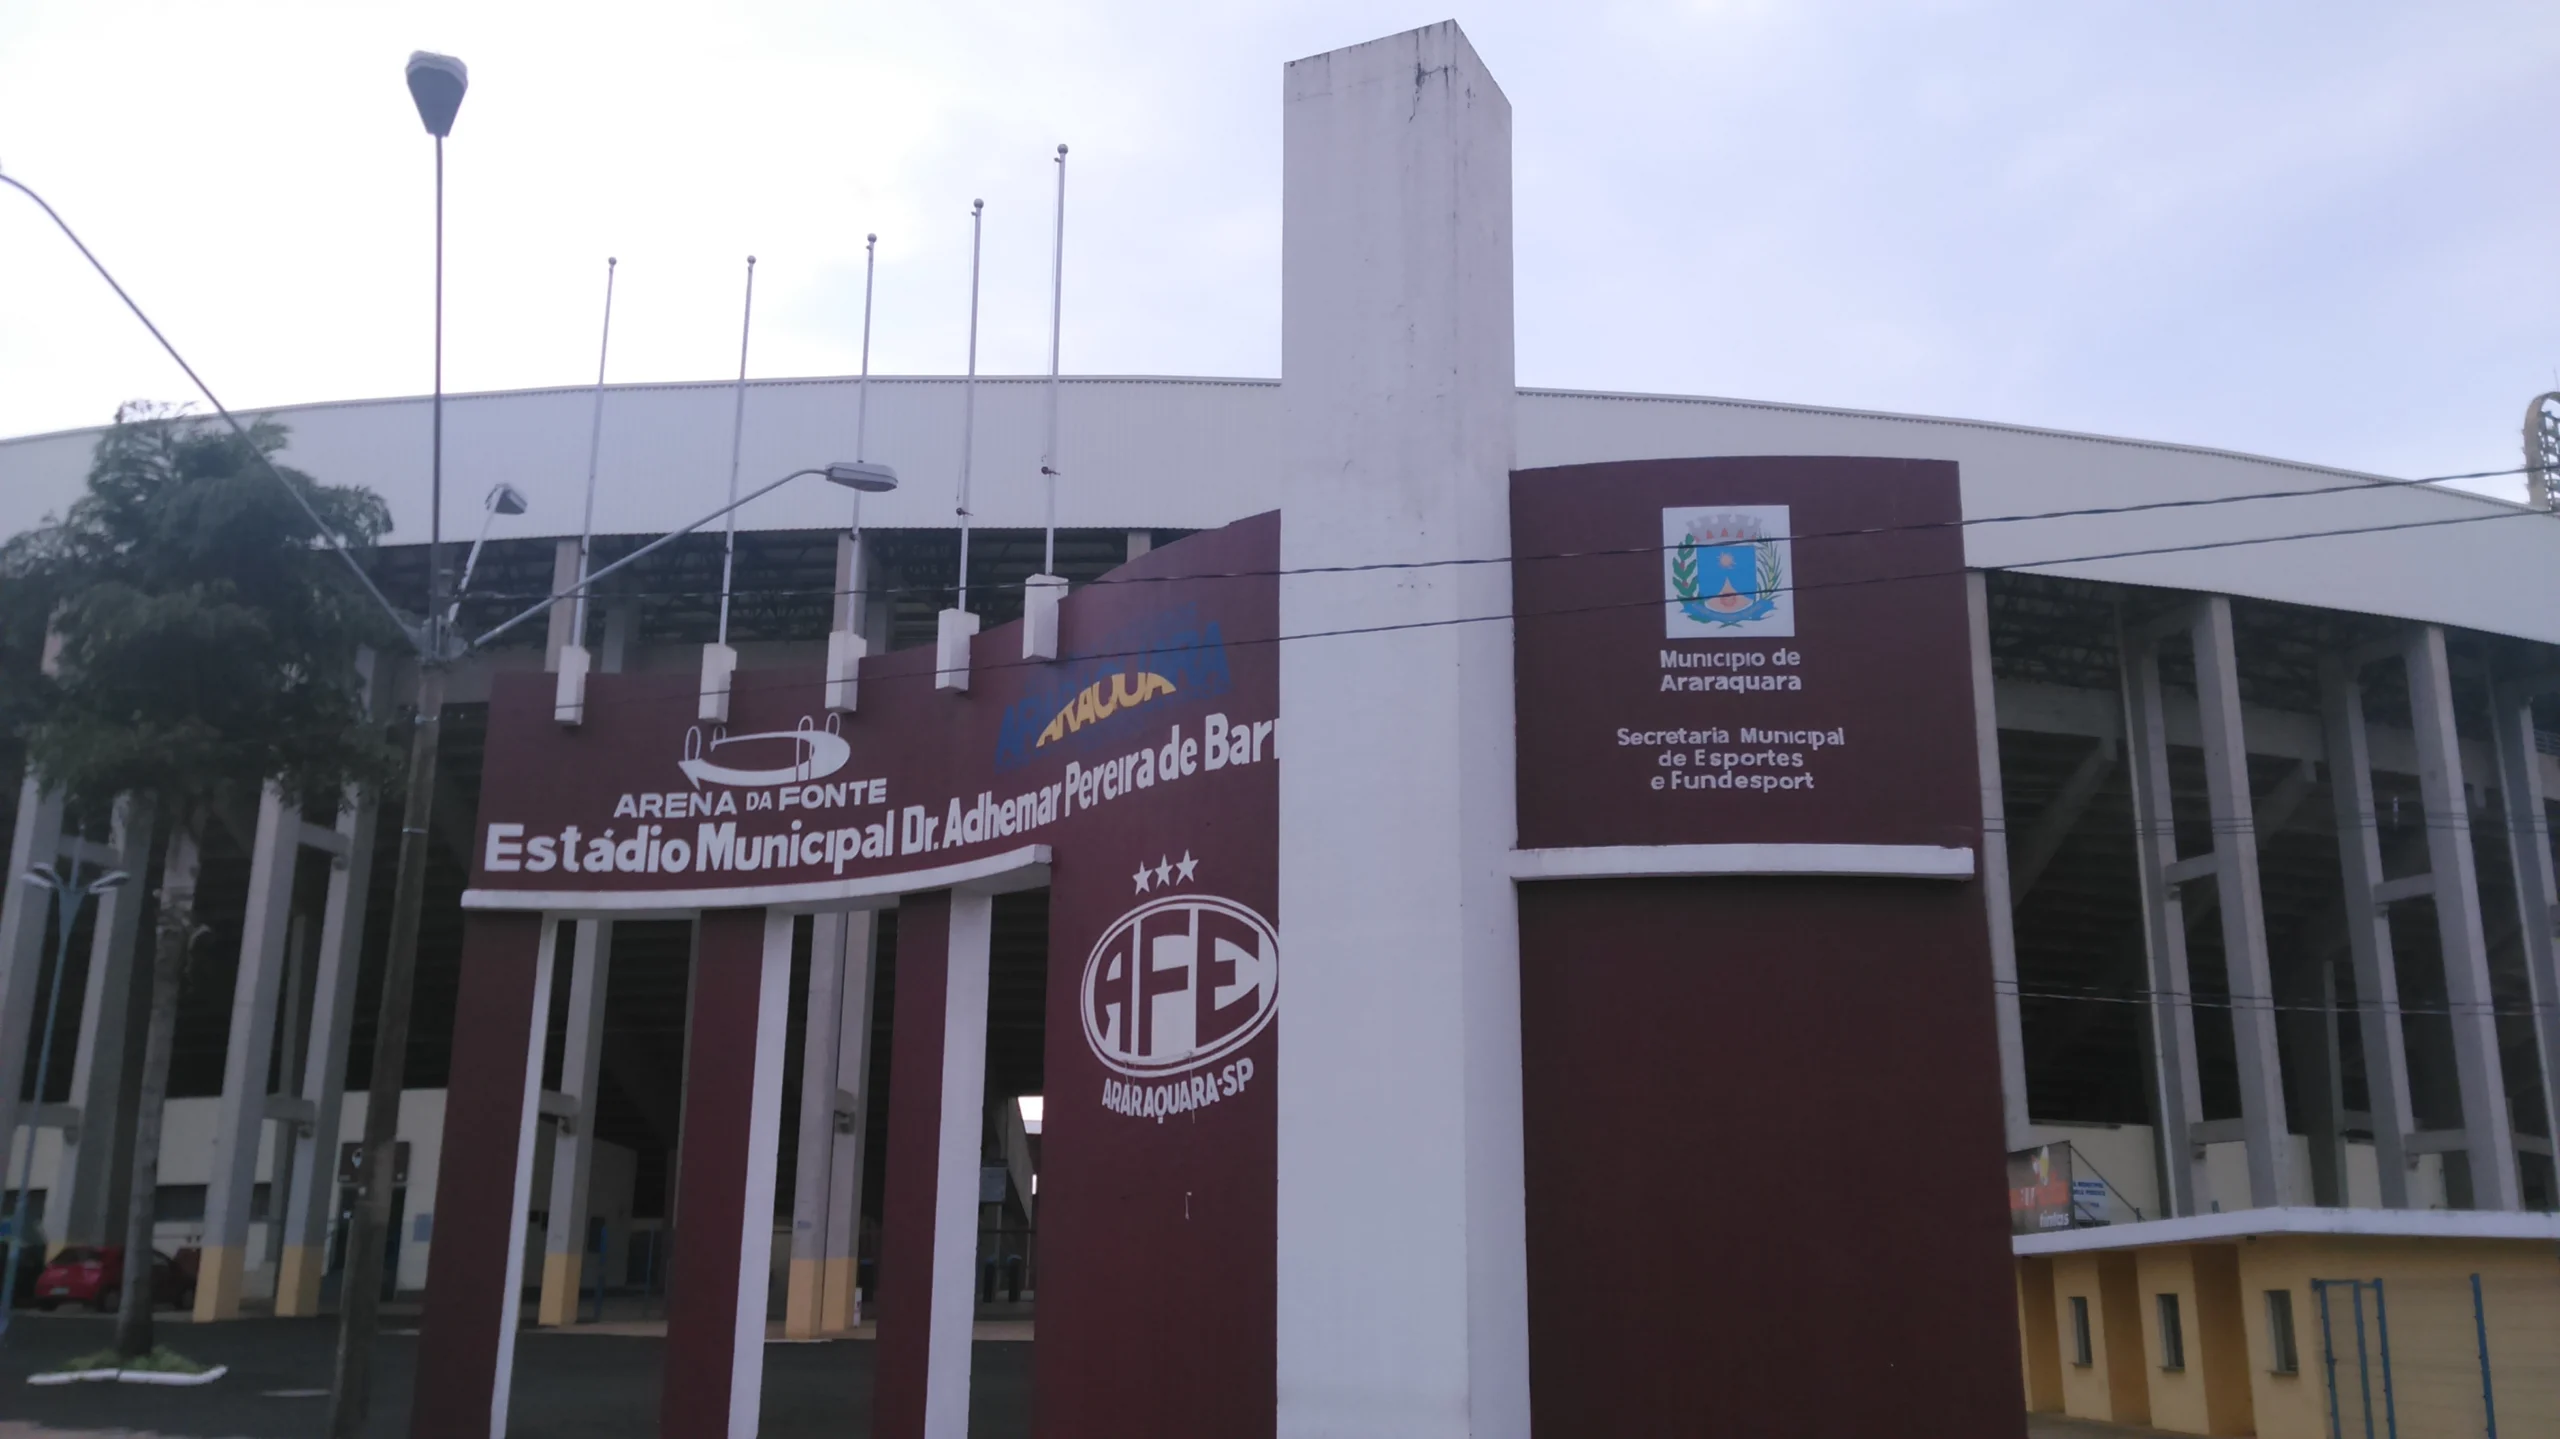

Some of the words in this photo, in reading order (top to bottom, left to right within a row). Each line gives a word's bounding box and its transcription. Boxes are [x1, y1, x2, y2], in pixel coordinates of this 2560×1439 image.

[1771, 648, 1801, 666] de
[1660, 674, 1802, 694] Araraquara
[1616, 727, 1730, 746] Secretaria
[1740, 727, 1845, 751] Municipal
[1658, 750, 1687, 767] de
[1695, 749, 1804, 770] Esportes
[1650, 775, 1665, 790] e
[1671, 770, 1815, 793] Fundesport
[484, 822, 692, 873] Estádio
[695, 809, 894, 875] Municipal
[900, 804, 941, 856] Dr.
[942, 781, 1063, 849] Adhemar
[1064, 747, 1155, 817] Pereira
[1158, 724, 1198, 781] de
[613, 791, 738, 818] ARENA
[746, 791, 772, 811] DA
[778, 778, 888, 811] FONTE
[1093, 907, 1260, 1058] AFE
